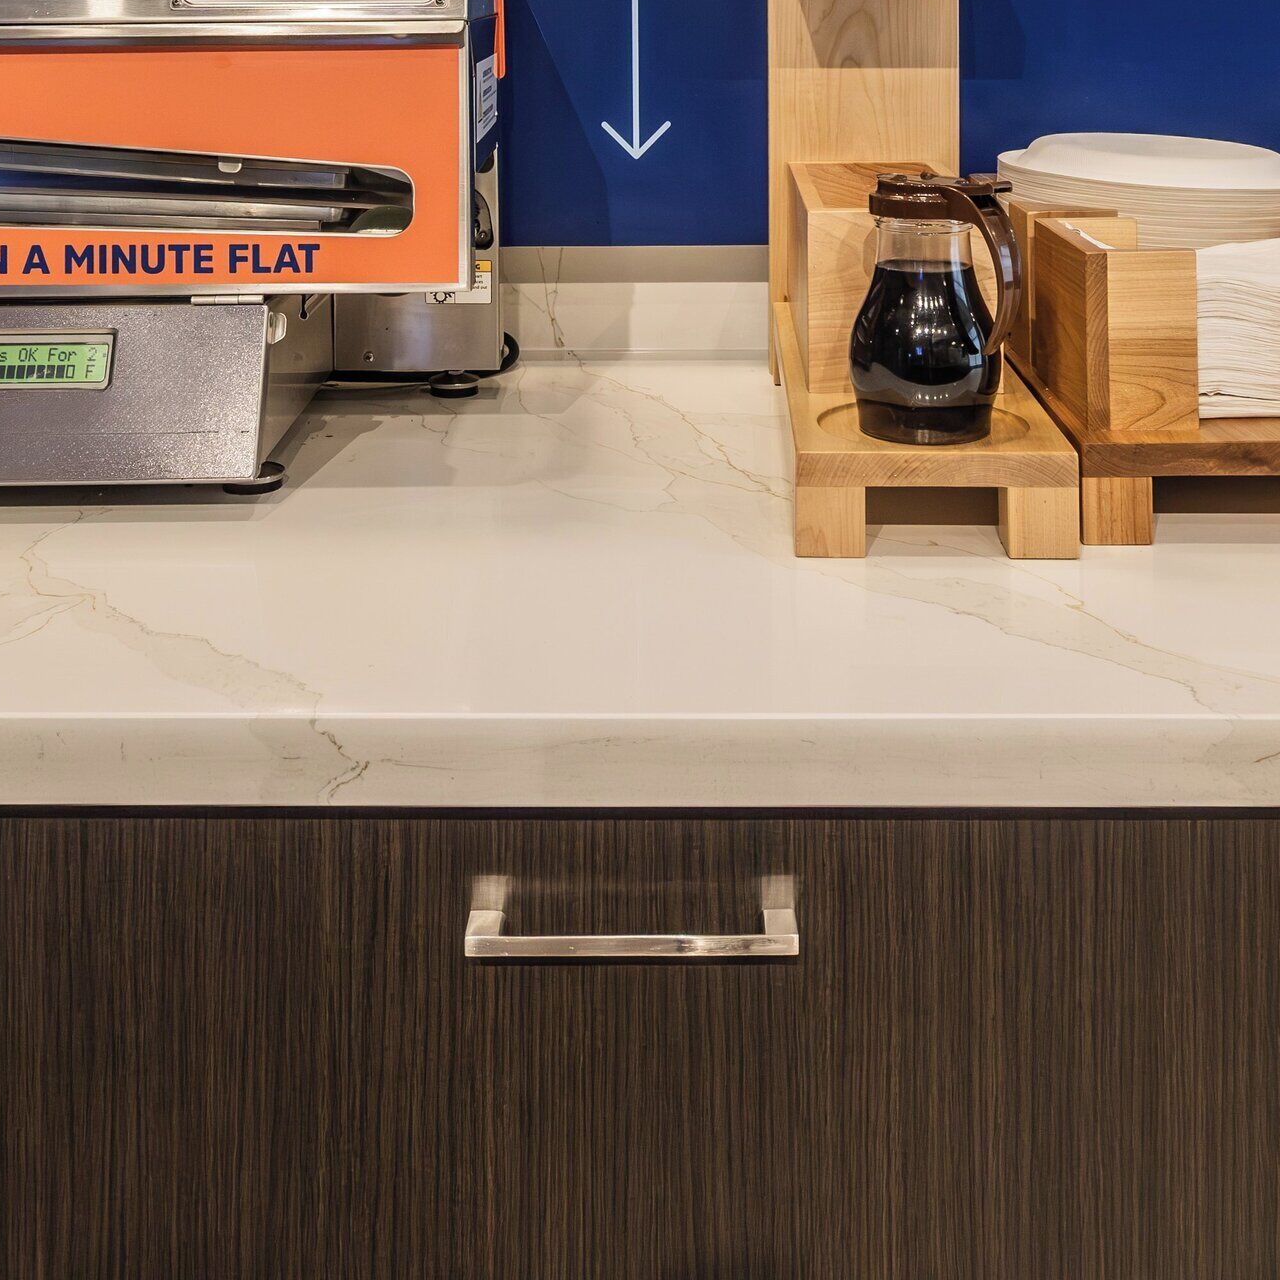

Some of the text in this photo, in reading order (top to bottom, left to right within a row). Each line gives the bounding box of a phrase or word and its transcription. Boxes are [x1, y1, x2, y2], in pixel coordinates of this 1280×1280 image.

[21, 244, 51, 275] A
[64, 243, 214, 275] MINUTE
[228, 243, 321, 274] FLAT
[18, 347, 39, 362] OK
[47, 347, 77, 362] For
[84, 364, 96, 379] F
